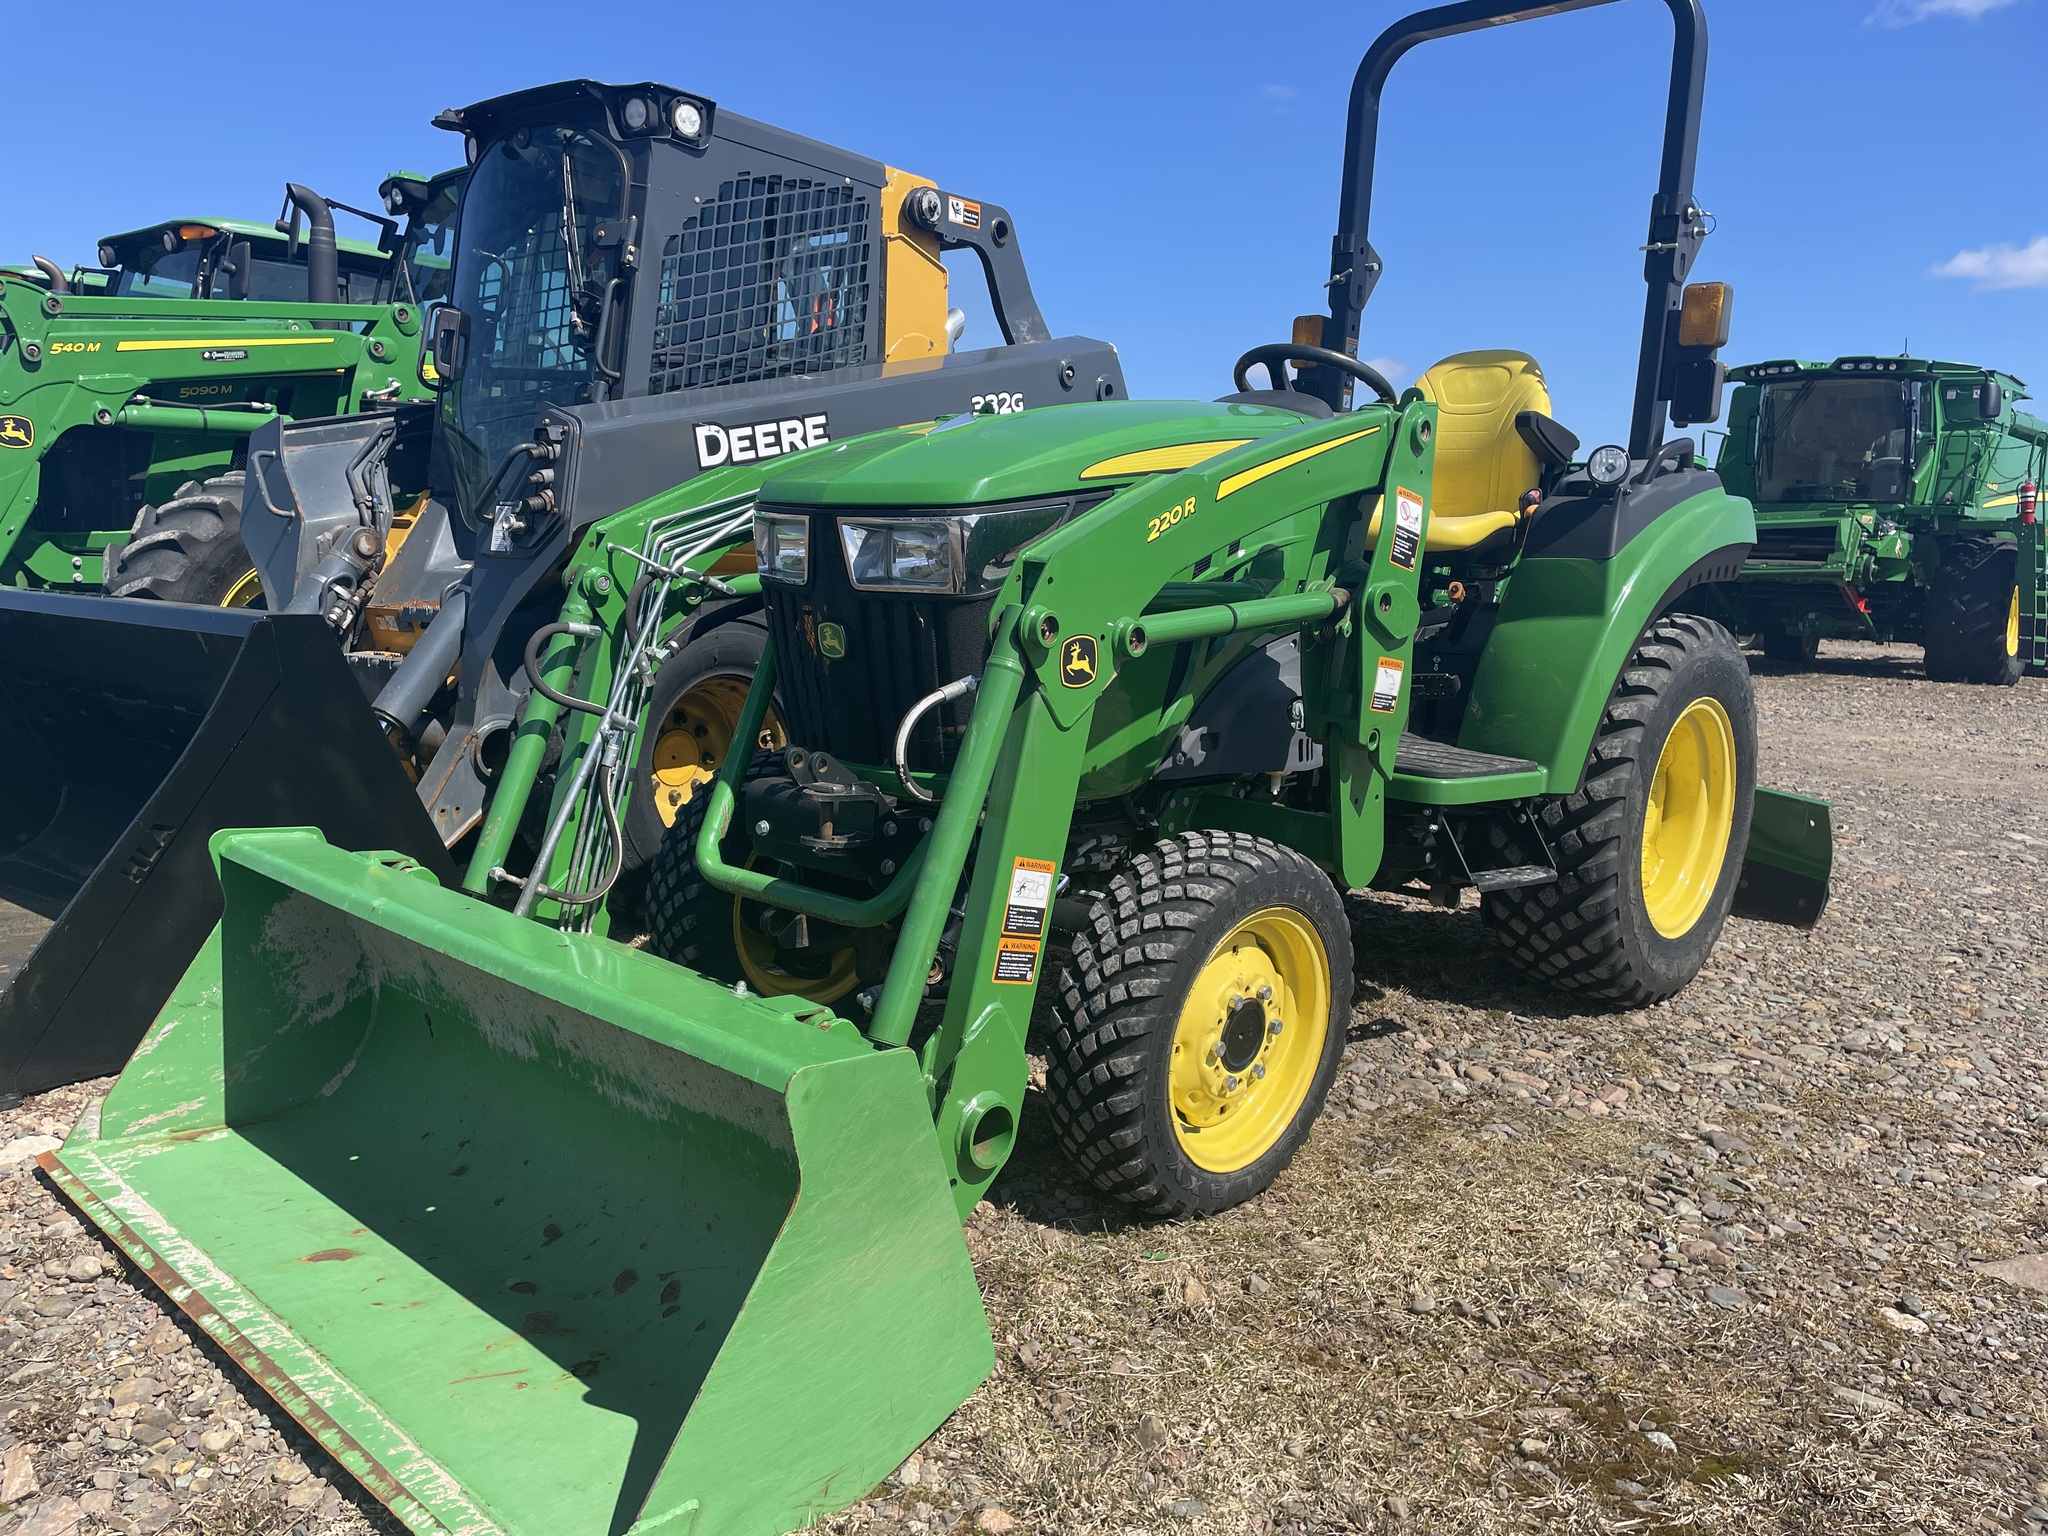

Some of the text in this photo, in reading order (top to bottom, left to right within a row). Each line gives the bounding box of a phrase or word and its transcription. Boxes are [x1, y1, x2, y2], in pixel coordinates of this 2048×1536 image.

[49, 342, 102, 355] 540 M
[179, 384, 233, 399] 5090 M
[694, 414, 830, 468] DEERE
[1147, 496, 1197, 543] 220 R
[1025, 860, 1051, 871] WARNING
[1010, 942, 1036, 951] WARNING
